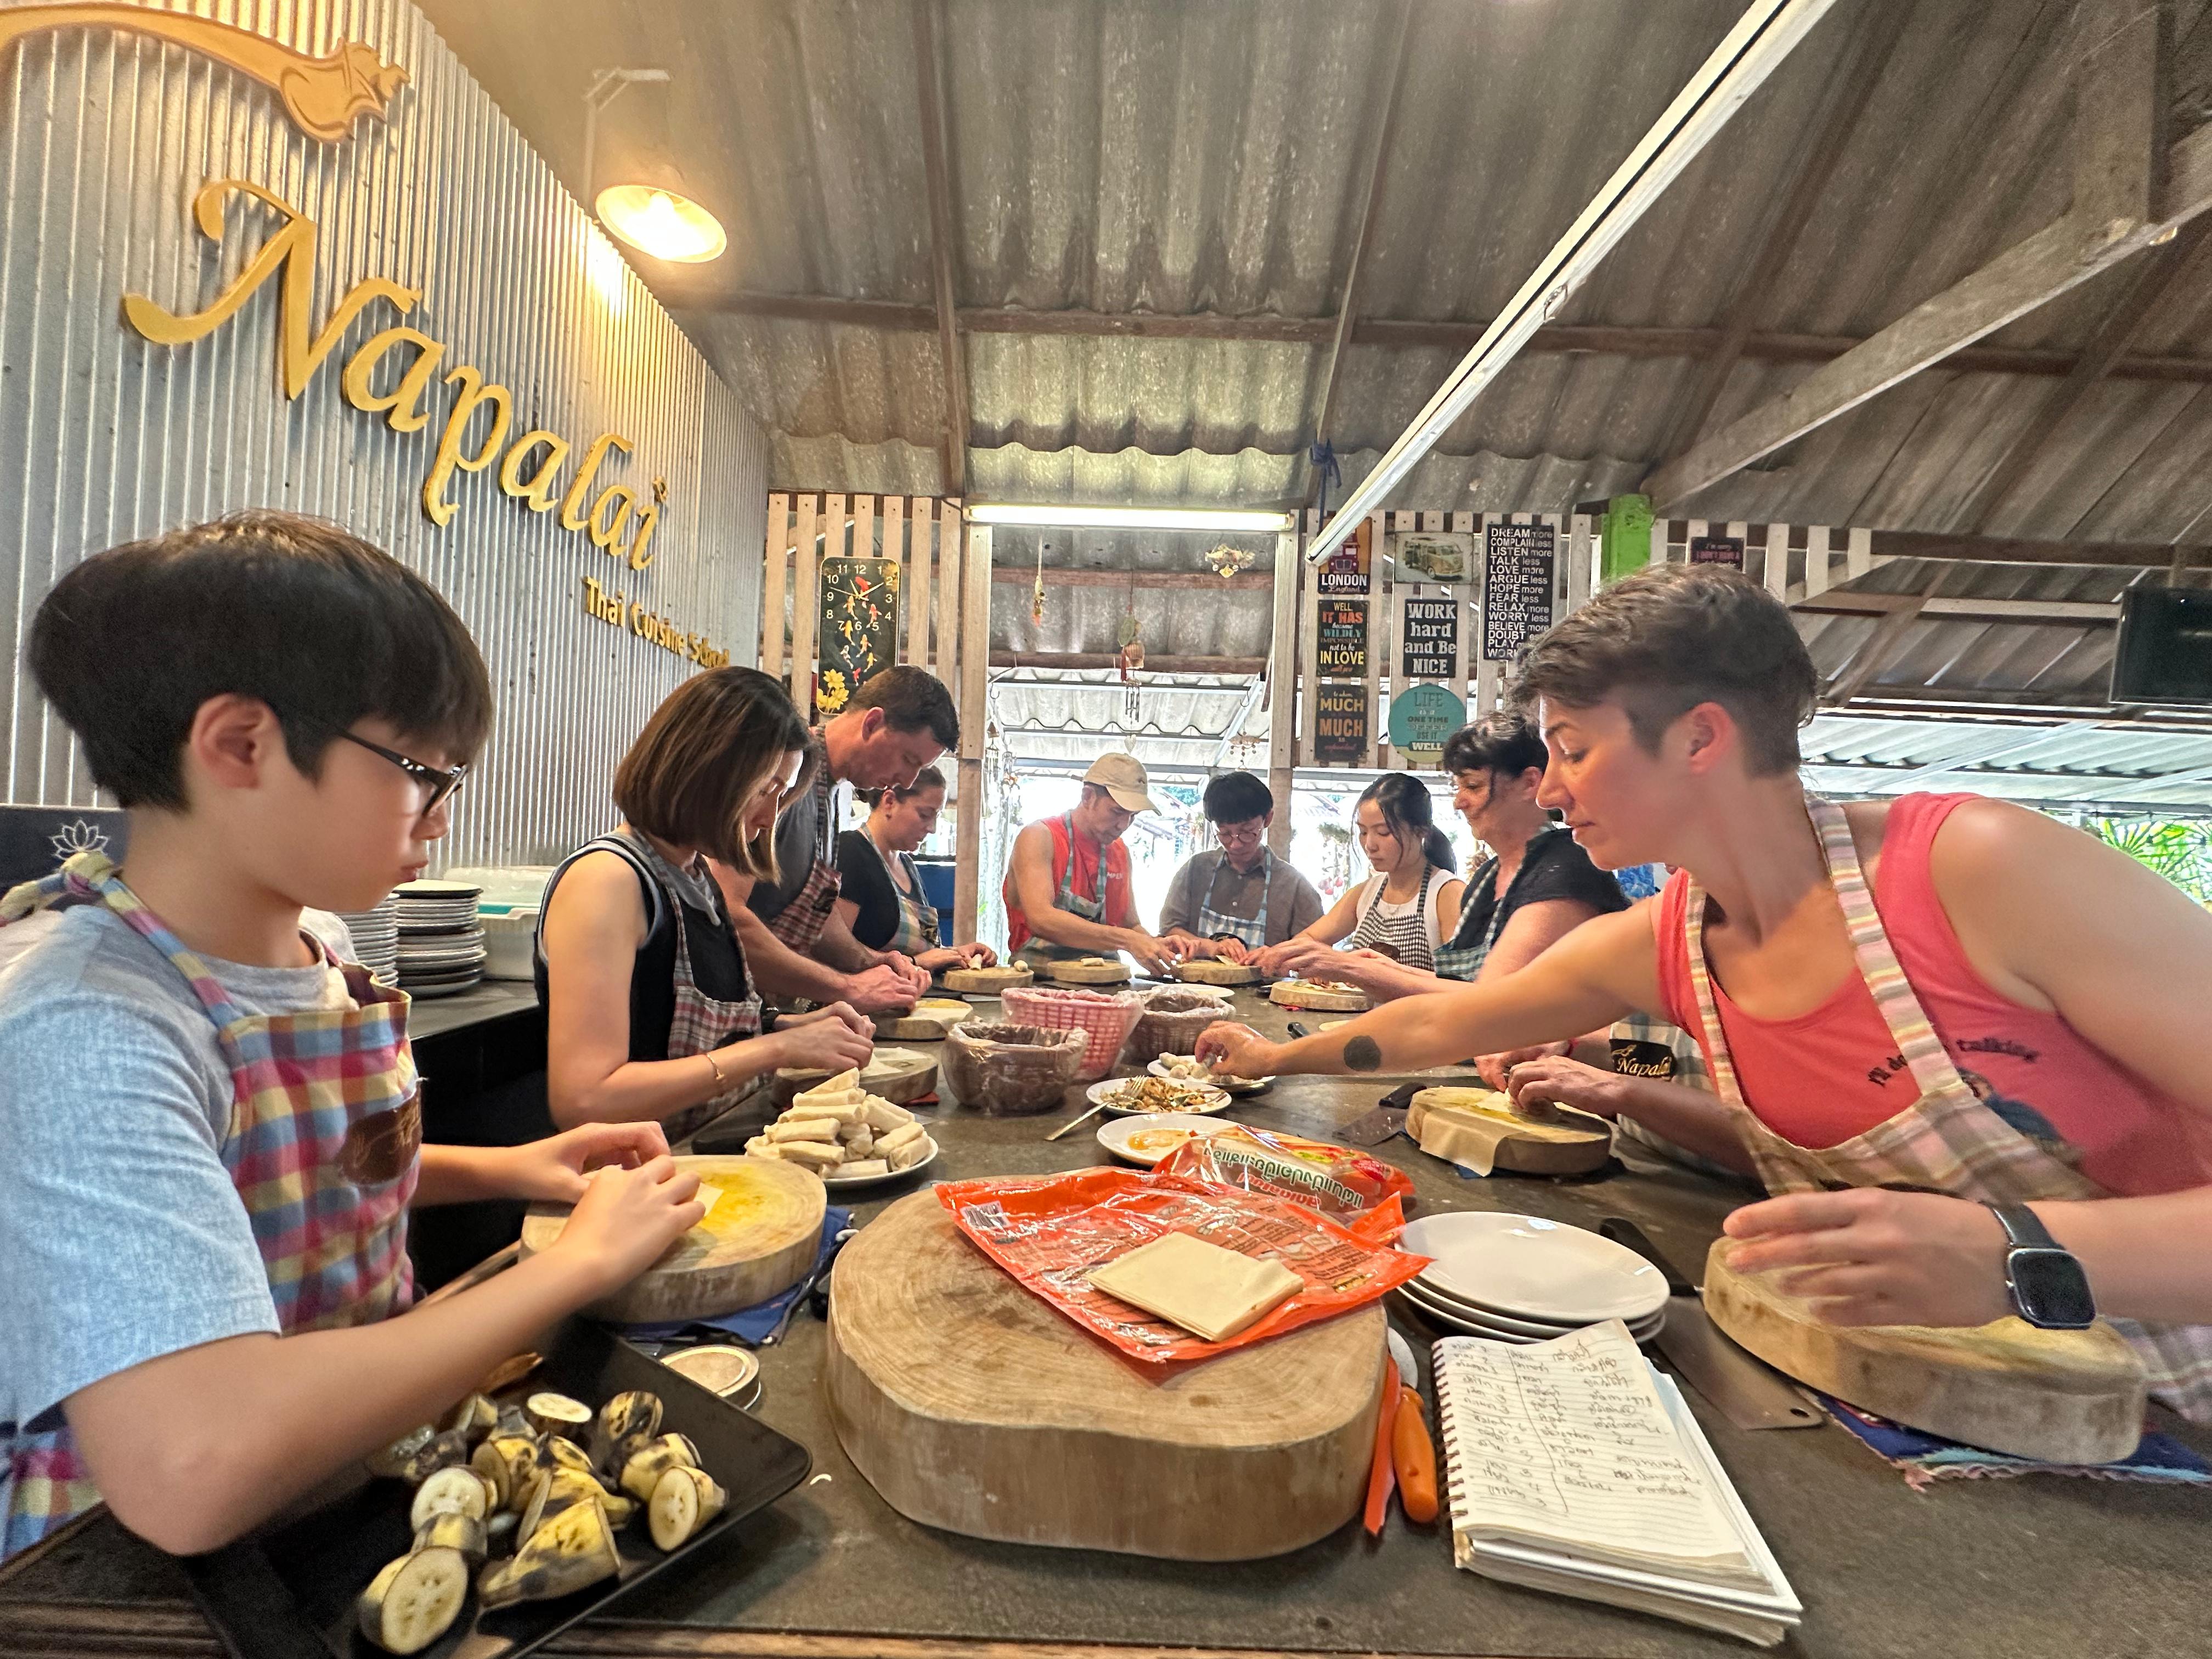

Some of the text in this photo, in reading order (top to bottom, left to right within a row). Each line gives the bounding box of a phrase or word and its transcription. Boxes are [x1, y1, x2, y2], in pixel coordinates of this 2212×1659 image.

[124, 179, 669, 571] Napalai
[1492, 528, 1530, 538] DREAM
[1491, 538, 1534, 547] COMPLAIN
[1491, 546, 1528, 556] LISTEN
[1490, 556, 1540, 566] TALK less
[838, 564, 882, 575] 11 12 1
[1490, 565, 1519, 574] LOVE
[827, 574, 893, 586] 10 2
[1321, 574, 1367, 586] LONDON
[1489, 574, 1548, 584] ARGUE less
[1489, 583, 1520, 593] HOPE
[827, 591, 893, 603] 9 3
[1489, 593, 1539, 603] FEAR less
[1407, 603, 1456, 619] WORK
[1489, 602, 1525, 612] RELAX
[582, 575, 626, 628] Thai
[630, 601, 687, 656] Cuisine
[826, 609, 891, 620] 8 4
[1322, 611, 1363, 624] IT HAS
[1488, 612, 1549, 622] WORRY less
[838, 620, 879, 631] 7 6 5
[1410, 622, 1452, 637] hard
[1488, 622, 1525, 630] BELIEVE
[1324, 629, 1362, 637] WILDLY
[1488, 630, 1526, 640] DOUBT
[1404, 640, 1457, 654] and Be
[1488, 639, 1516, 648] PLAY
[1320, 651, 1364, 665] IN LOVE
[1413, 658, 1448, 674] NICE
[1414, 692, 1443, 707] LIFE
[1320, 698, 1364, 712] MUCH
[1319, 718, 1363, 737] MUCH
[1407, 724, 1448, 732] OFFER
[1417, 731, 1437, 740] USE IT
[1412, 741, 1443, 751] WELL
